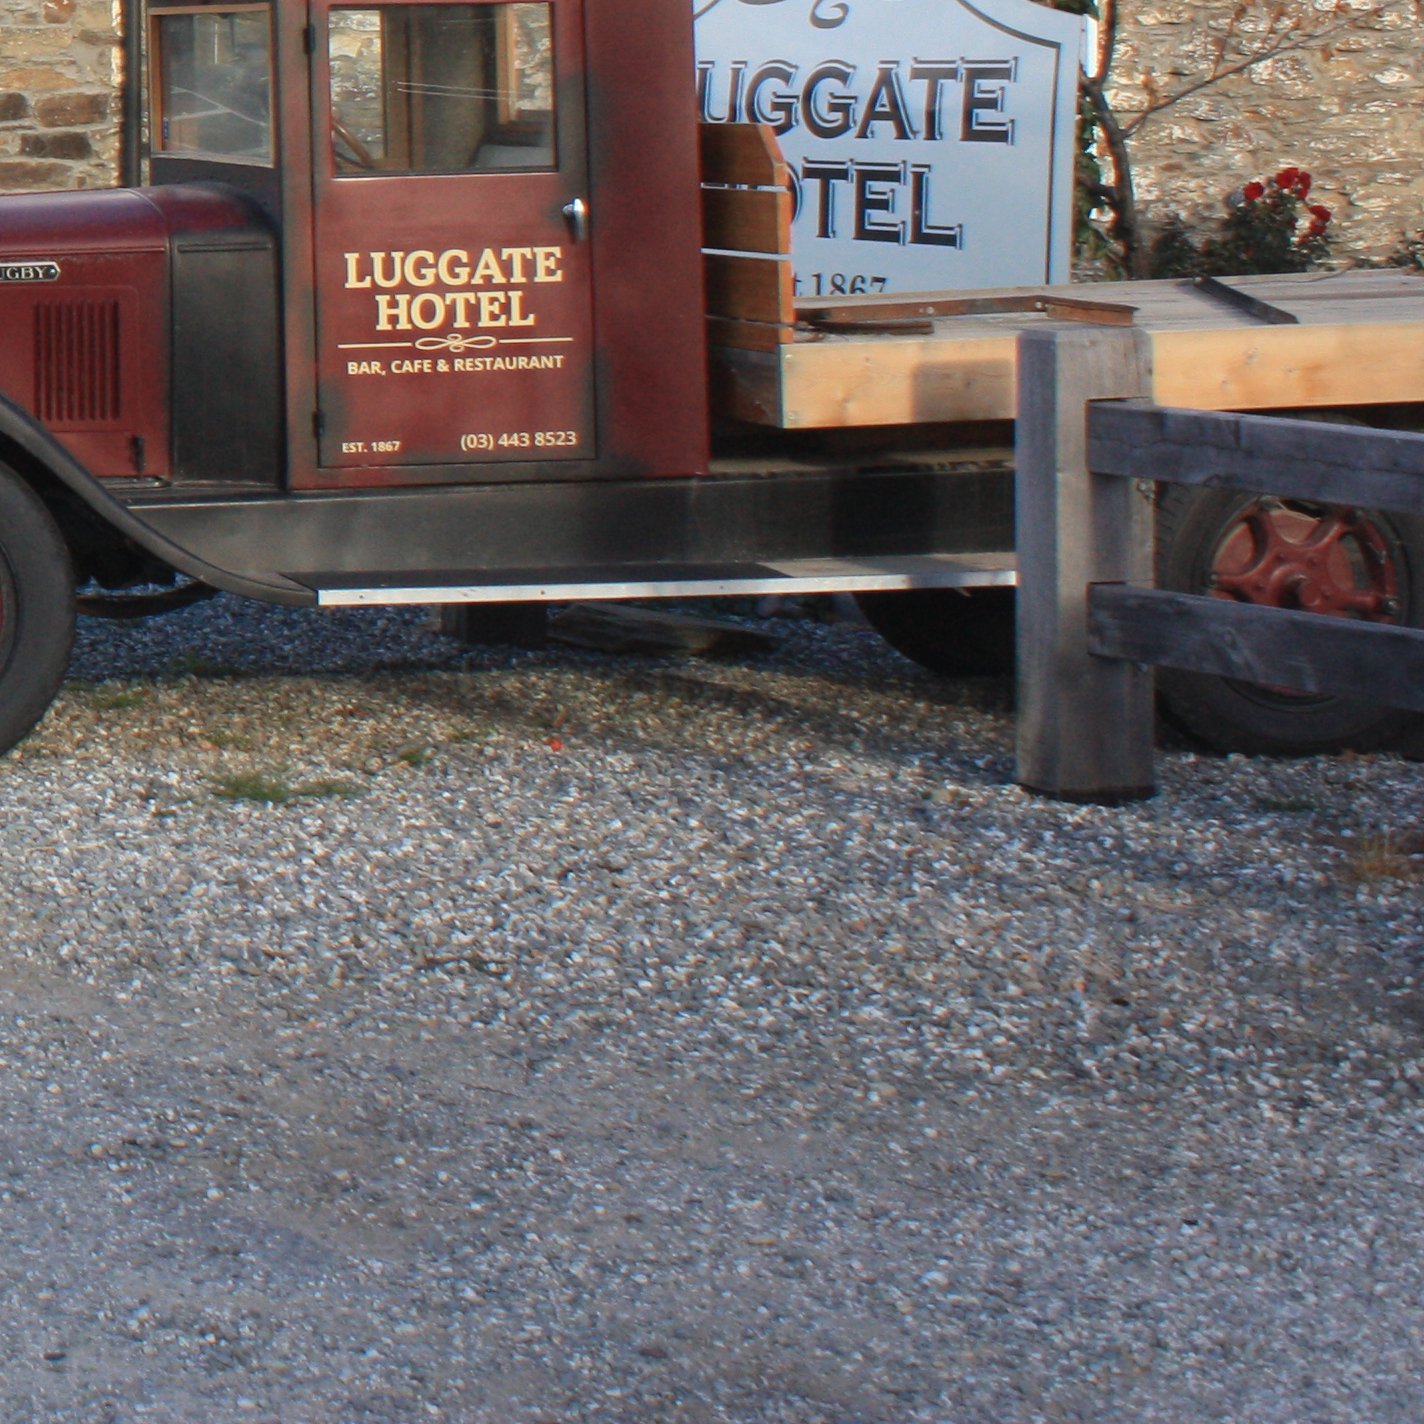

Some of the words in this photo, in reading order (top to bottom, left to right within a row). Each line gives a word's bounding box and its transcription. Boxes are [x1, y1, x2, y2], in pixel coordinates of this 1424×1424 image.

[696, 56, 1019, 146] UGGATE
[785, 156, 964, 251] TEL
[344, 246, 563, 289] LUGGATE
[374, 290, 536, 331] HOTEL
[347, 360, 386, 376] BAR,
[390, 359, 432, 374] CAFE
[436, 359, 450, 372] &
[454, 355, 564, 372] RESTAURANT
[342, 442, 368, 454] EST.
[371, 440, 401, 452] 1867
[460, 433, 494, 451] (03)
[498, 432, 531, 448] 443
[534, 431, 577, 447] 8523
